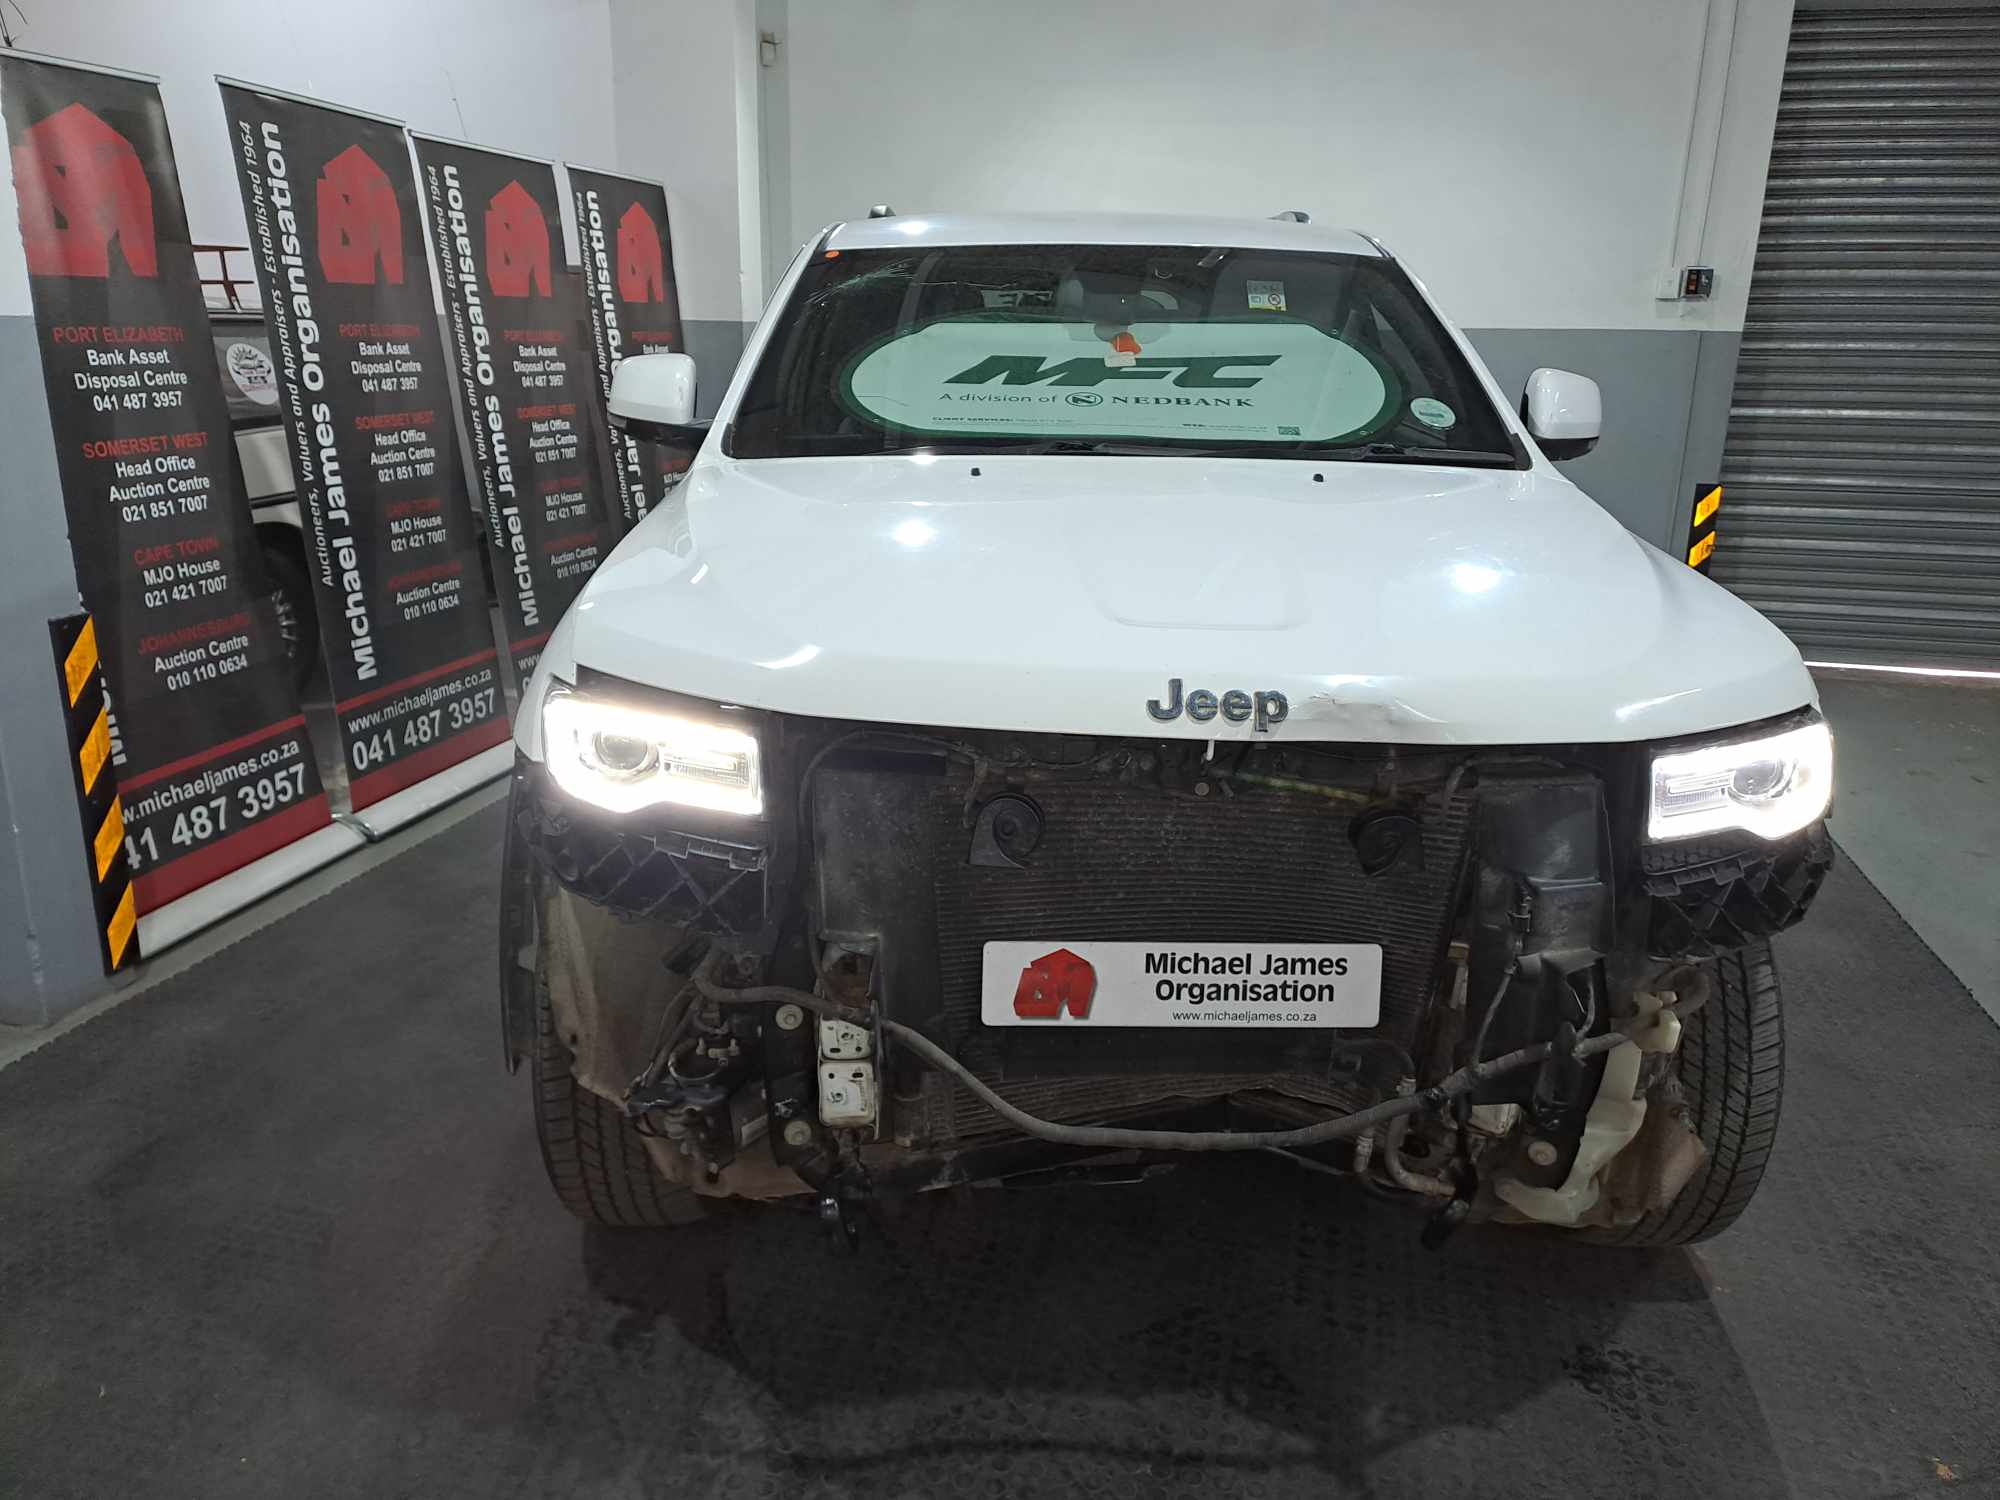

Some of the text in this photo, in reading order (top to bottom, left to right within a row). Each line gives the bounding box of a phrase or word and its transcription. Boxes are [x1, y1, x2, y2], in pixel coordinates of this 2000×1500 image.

[239, 120, 258, 168] 1964
[426, 165, 443, 203] 1964
[248, 170, 278, 274] Established
[432, 204, 457, 289] Established
[577, 224, 596, 298] Established
[442, 164, 495, 386] Organisation
[53, 325, 184, 344] PORT ELIZABETH
[271, 288, 296, 380] Appraisers
[451, 300, 471, 377] Appraisers
[590, 306, 610, 373] Appraisers
[86, 348, 170, 366] Bank Asset
[359, 342, 385, 356] Bank
[74, 369, 188, 392] Disposal Centre
[351, 359, 422, 377] Disposal Centre
[513, 361, 544, 374] Disposal
[943, 354, 1283, 389] MFC
[361, 376, 418, 393] 041 487 3957
[464, 379, 477, 408] and
[93, 391, 183, 412] 041 487 3957
[260, 121, 377, 681] Michael James Organisation
[289, 385, 303, 417] and
[938, 392, 952, 402] A
[959, 391, 1040, 404] division
[1041, 392, 1057, 403] of
[1112, 396, 1255, 408] NEDBANK
[82, 431, 209, 459] SOMERSET WEST
[375, 429, 426, 446] Head Office
[470, 408, 488, 460] Valuers
[484, 395, 516, 498] James
[529, 435, 555, 449] Auction
[296, 420, 315, 481] Valuers
[370, 446, 436, 465] Auction Centre
[115, 455, 196, 478] Head Office
[378, 462, 434, 483] 021 851 7007
[108, 474, 210, 503] Auction Centre
[560, 490, 583, 504] House
[122, 494, 208, 523] 021 851 7007
[481, 465, 505, 548] Auctioneers,
[310, 487, 334, 587] Auctioneers,
[391, 514, 442, 534] MJO House
[134, 543, 173, 566] CAPE
[391, 528, 447, 552] 021 421 7007
[143, 558, 221, 587] MJO House
[502, 506, 540, 627] Michael
[551, 552, 575, 567] Auction
[144, 575, 228, 609] 021 421 7007
[396, 577, 461, 605] Auction Centre
[404, 593, 460, 621] 010 110 0634
[154, 633, 249, 673] Auction Centre
[166, 654, 248, 691] 010 110 0634
[347, 667, 492, 735] www.michaeljames.co.za
[1147, 677, 1289, 734] Jeep
[352, 687, 496, 771] 041 487 3957
[171, 794, 229, 848] 487
[236, 761, 306, 820] 3957
[1144, 952, 1348, 976] Michael James
[1154, 978, 1336, 1005] Organisation
[1172, 1010, 1318, 1024] www.michaeljames.co.za
